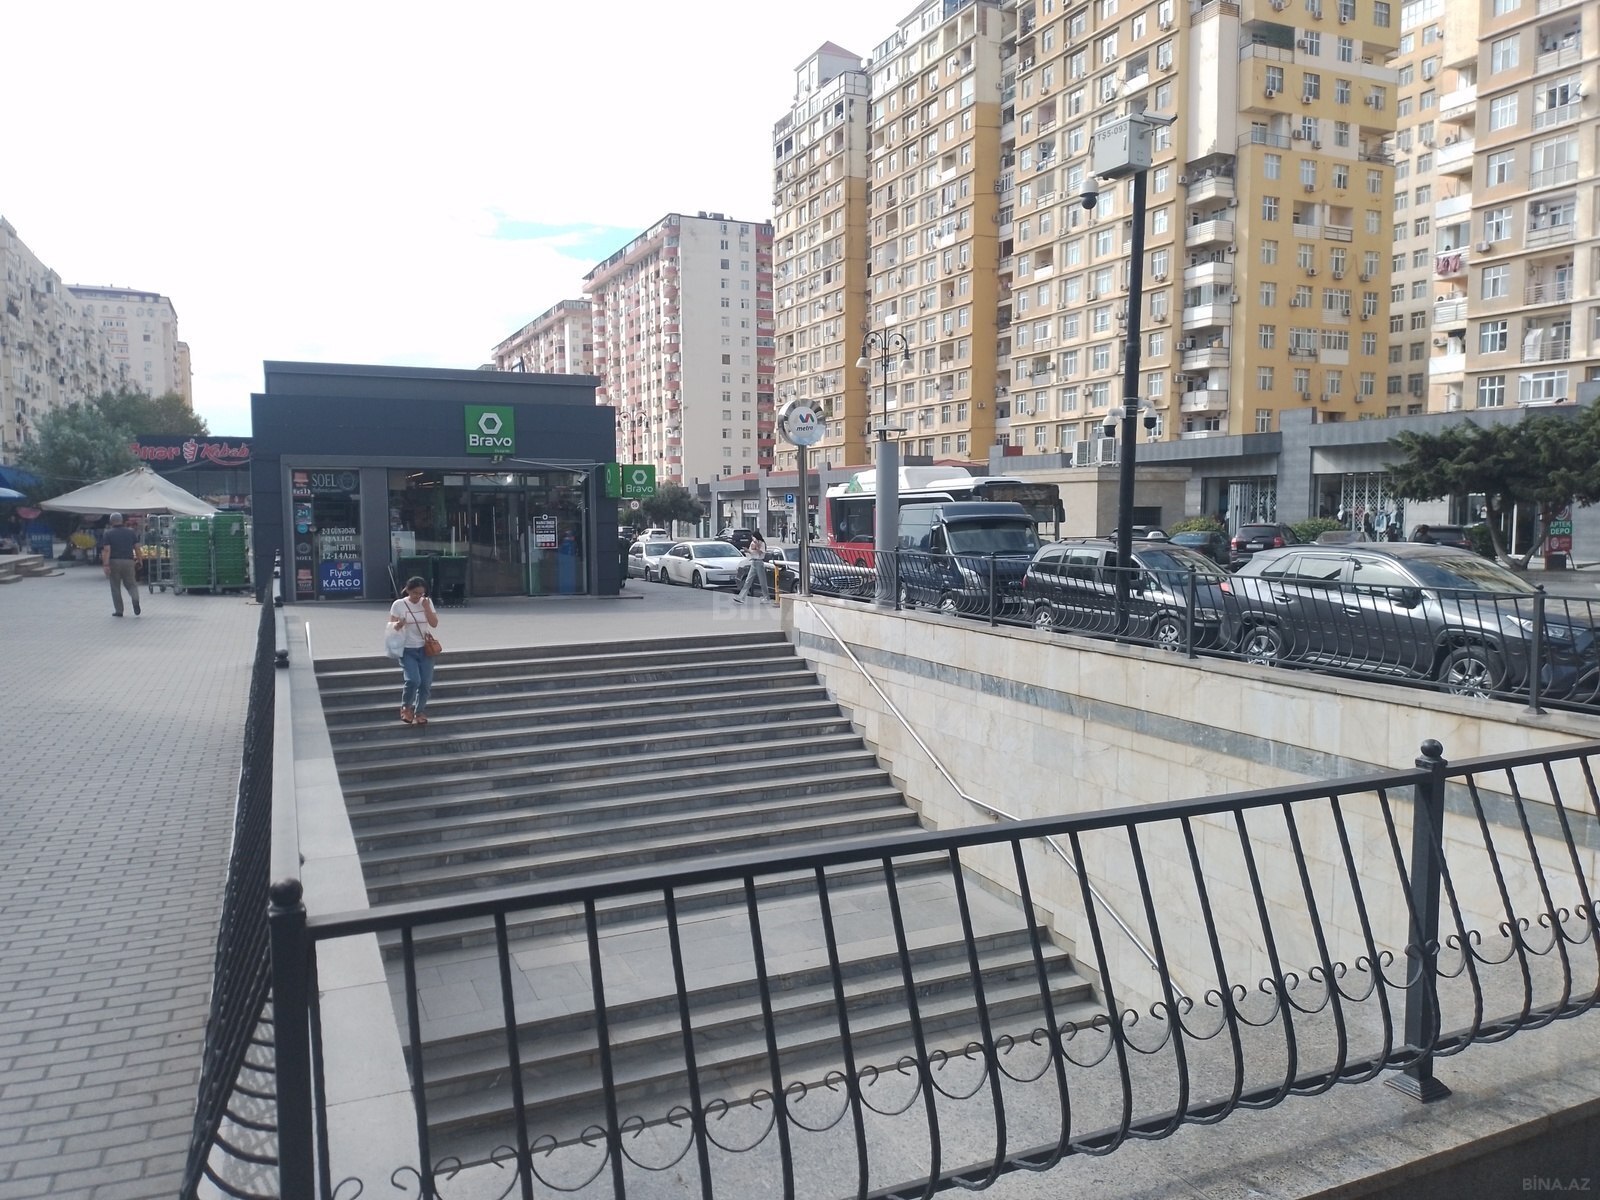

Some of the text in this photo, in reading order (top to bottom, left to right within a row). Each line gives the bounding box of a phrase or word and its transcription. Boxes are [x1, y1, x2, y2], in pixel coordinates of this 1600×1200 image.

[469, 434, 512, 447] Bravo
[311, 473, 337, 487] SOEL
[625, 484, 654, 493] Bravo
[786, 494, 793, 503] P
[1550, 527, 1570, 535] DEPO
[329, 569, 352, 578] Flyex
[322, 579, 361, 587] KARGO
